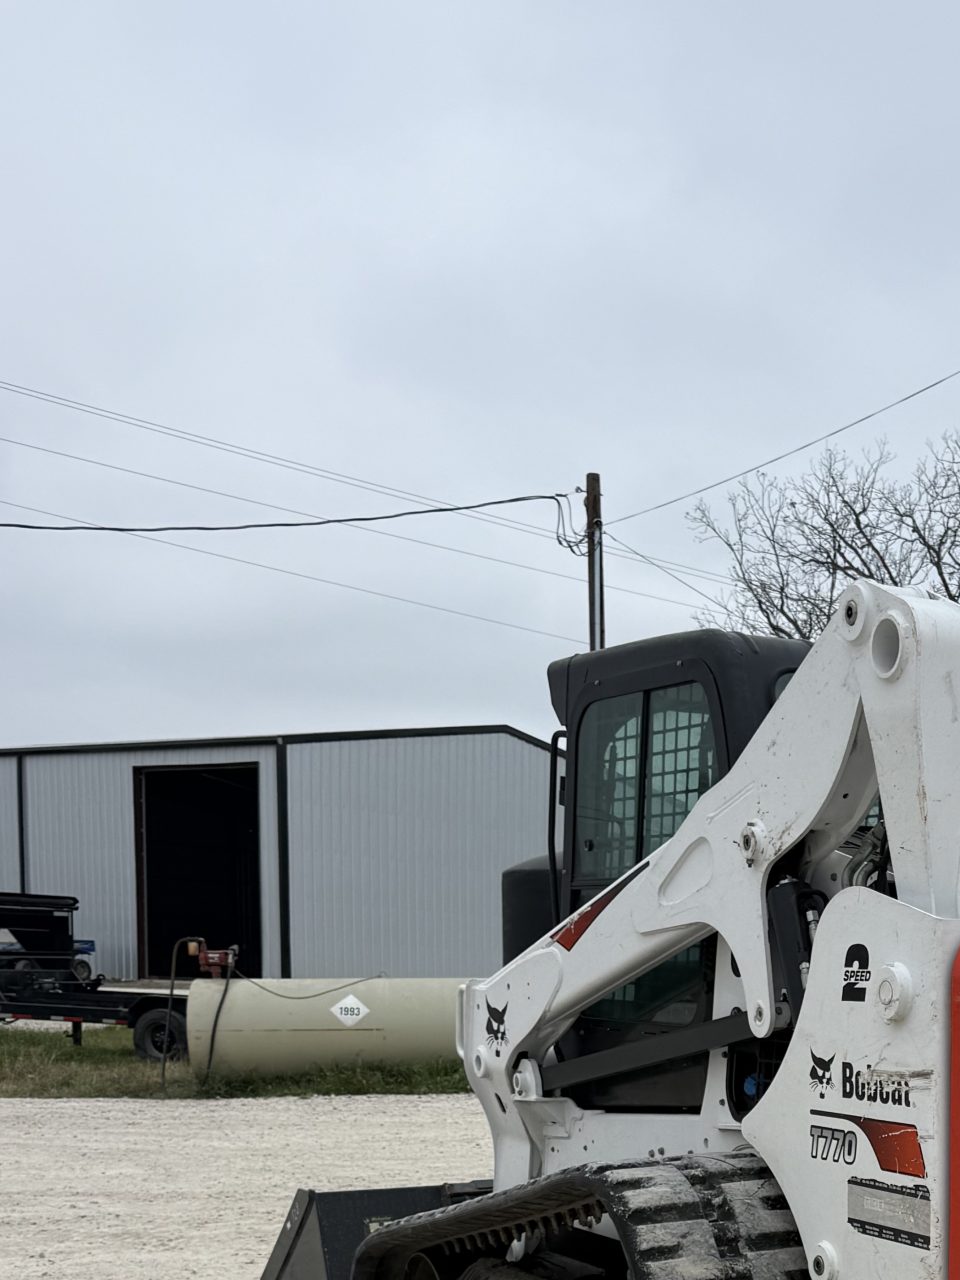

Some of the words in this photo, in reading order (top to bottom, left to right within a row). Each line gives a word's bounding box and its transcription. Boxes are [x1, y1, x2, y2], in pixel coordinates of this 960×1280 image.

[841, 943, 869, 1002] 2
[843, 970, 872, 982] SPEED
[339, 1006, 361, 1017] 1993
[810, 1124, 857, 1165] T770
